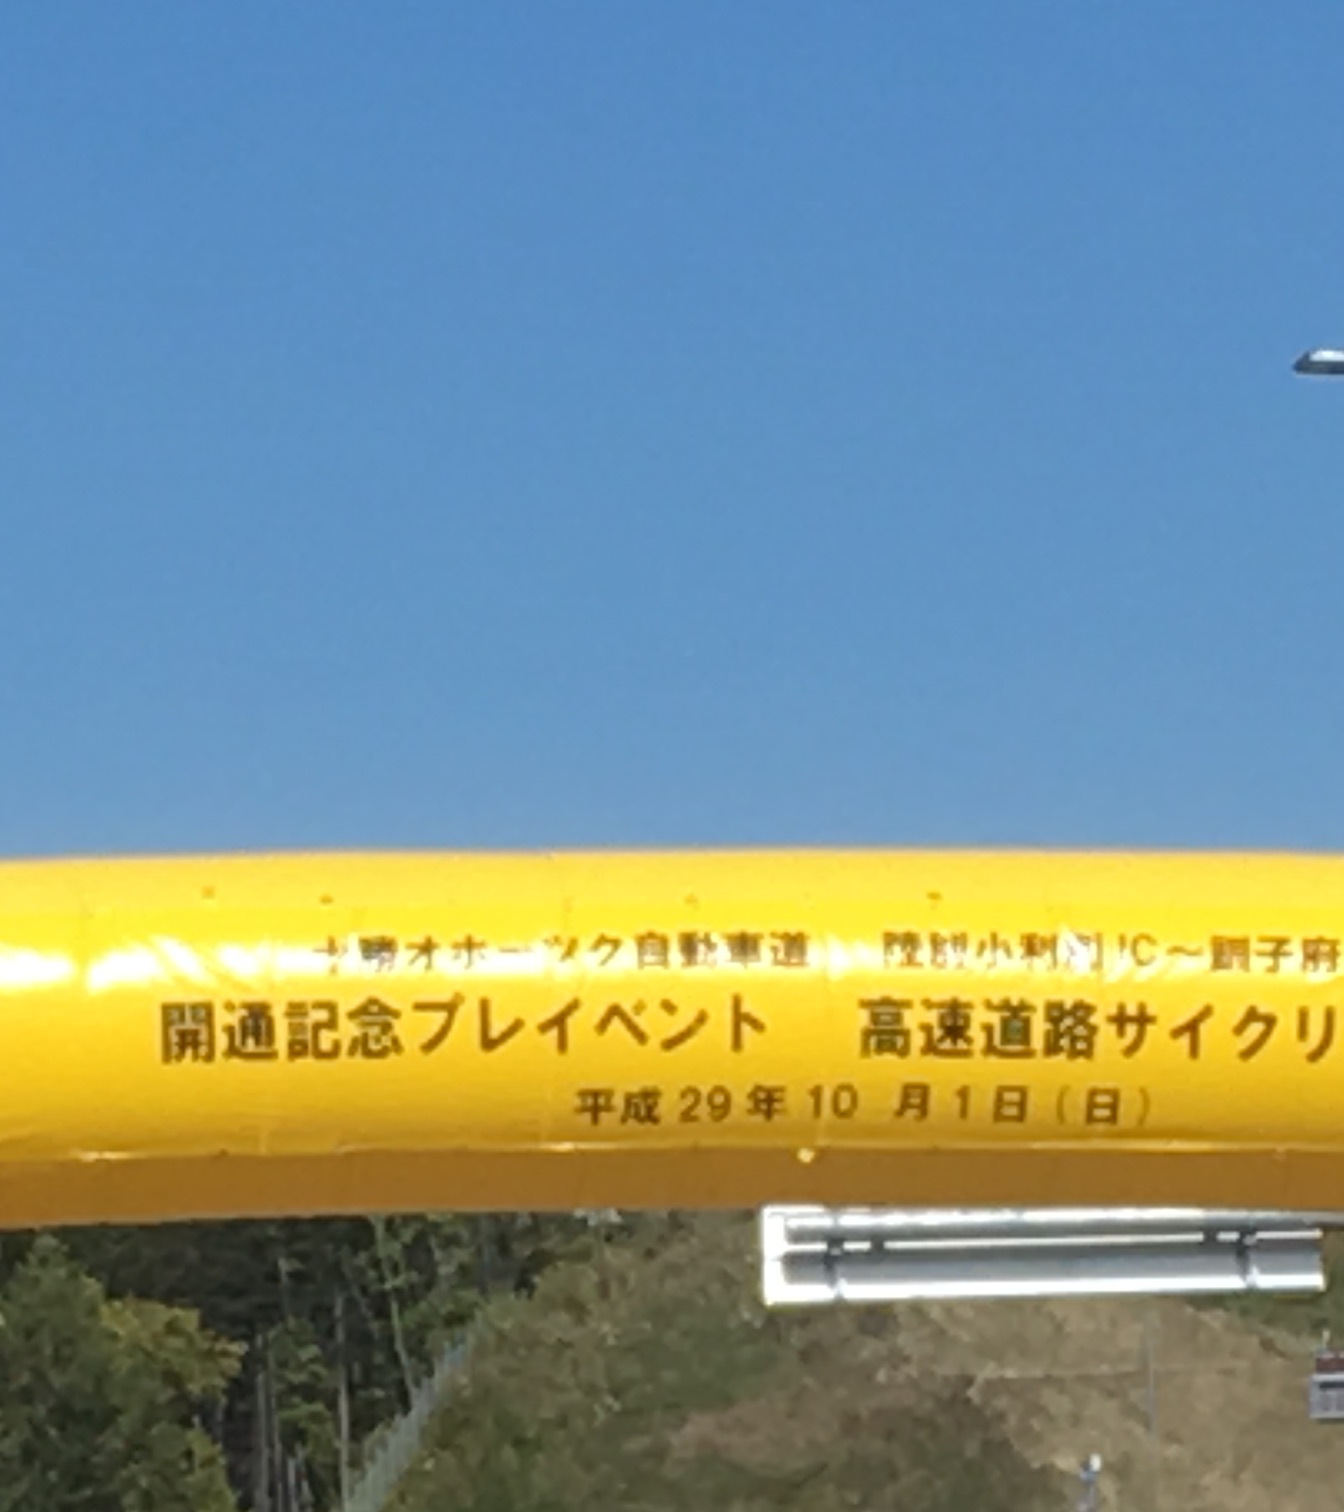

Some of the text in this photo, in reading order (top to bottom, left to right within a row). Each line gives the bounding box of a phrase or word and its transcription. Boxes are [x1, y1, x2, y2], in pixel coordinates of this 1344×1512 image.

[160, 991, 767, 1064] 開通記念プレイベント
